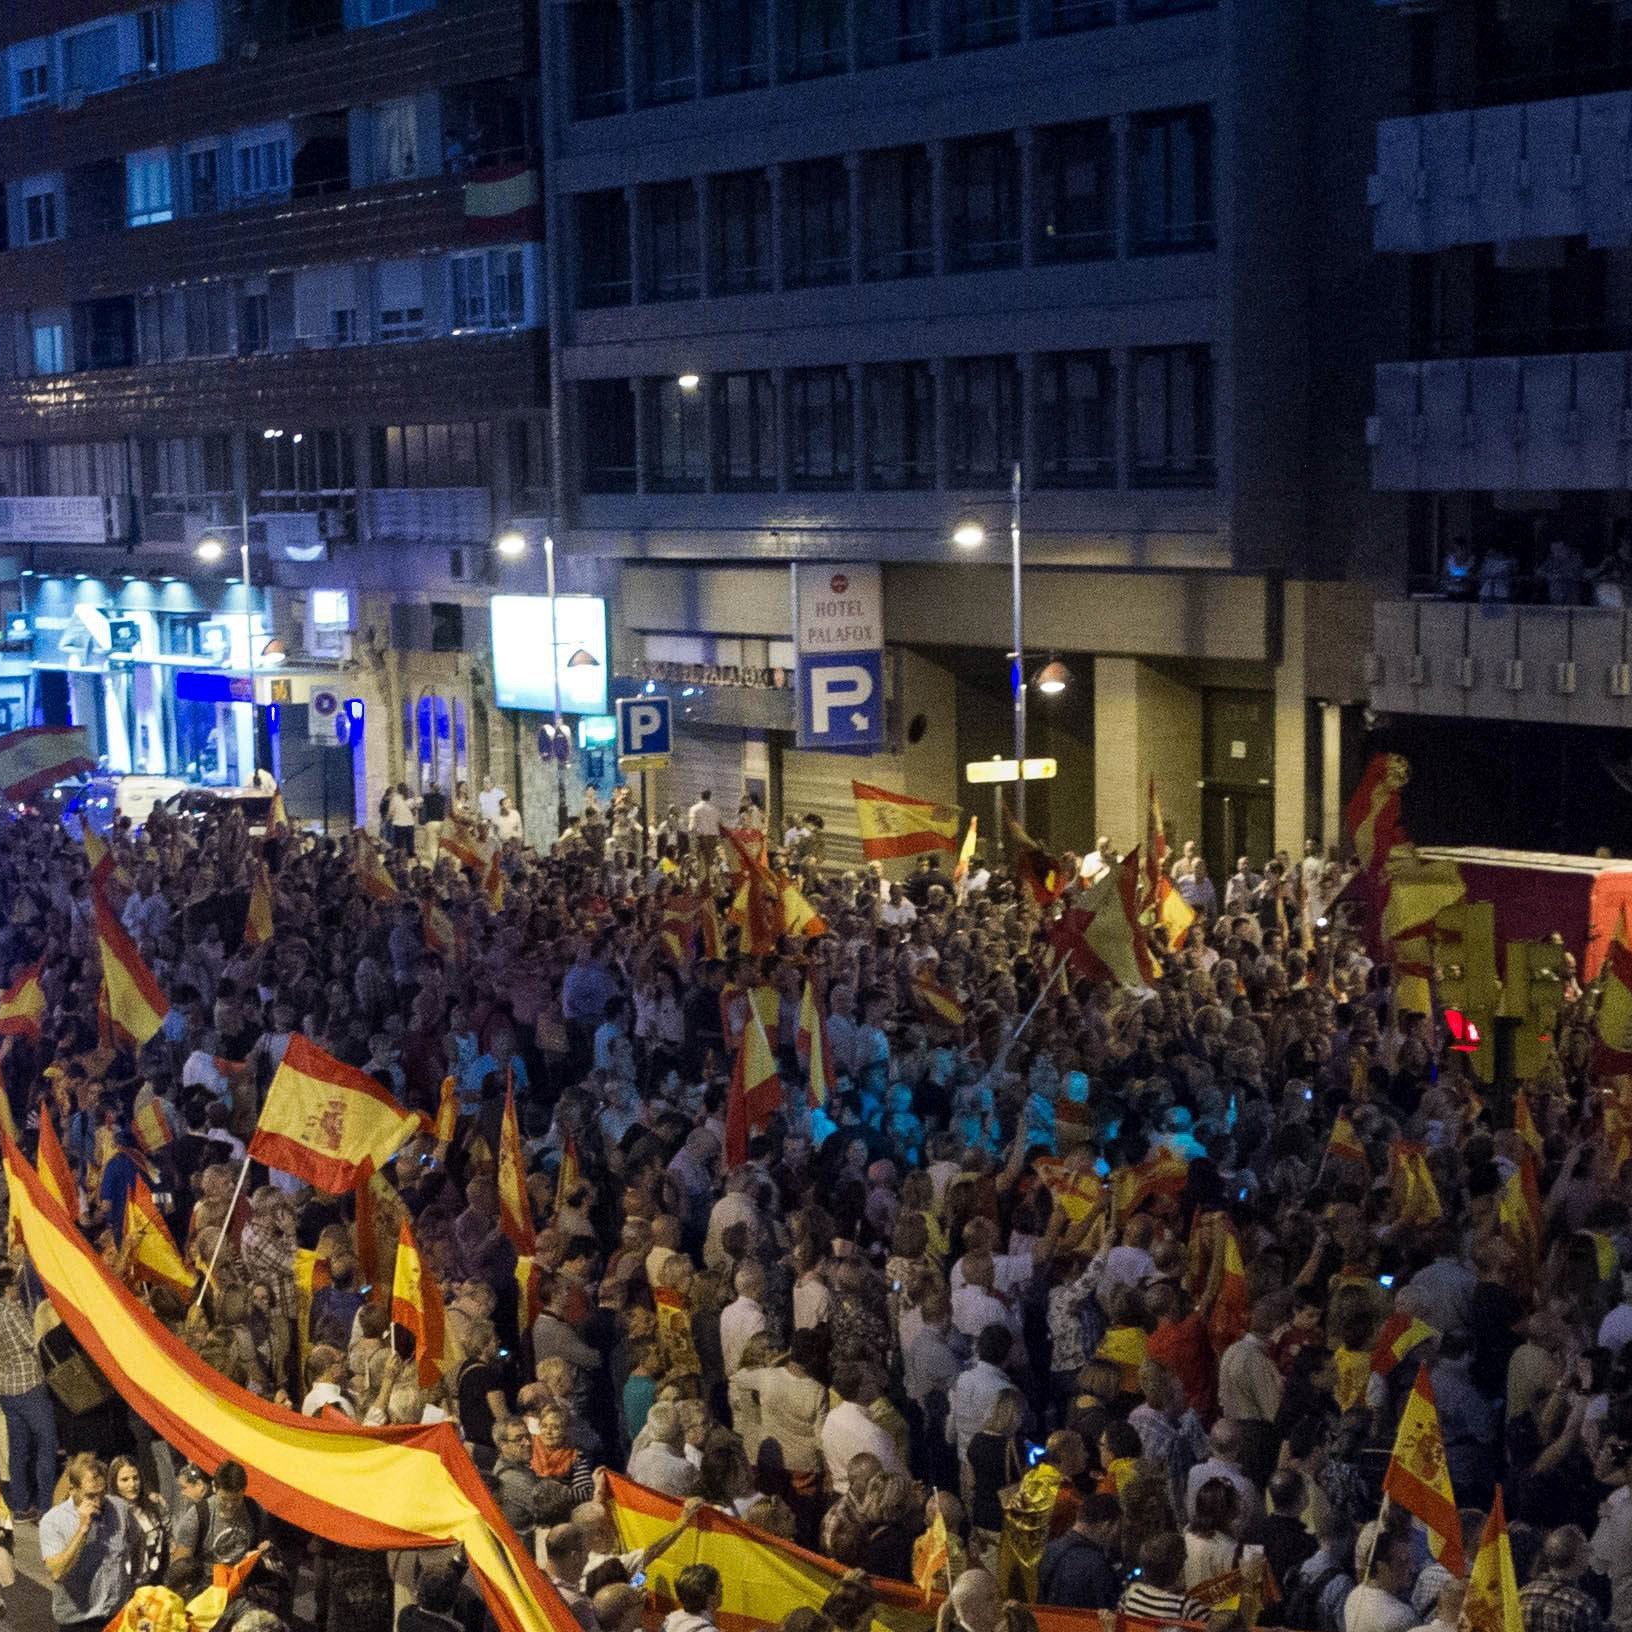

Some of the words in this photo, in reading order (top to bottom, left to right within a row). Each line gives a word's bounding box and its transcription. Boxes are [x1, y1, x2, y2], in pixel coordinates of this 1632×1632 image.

[815, 600, 864, 618] HOTEL
[808, 626, 872, 644] PALAFOX
[810, 665, 873, 734] P
[630, 705, 661, 750] P
